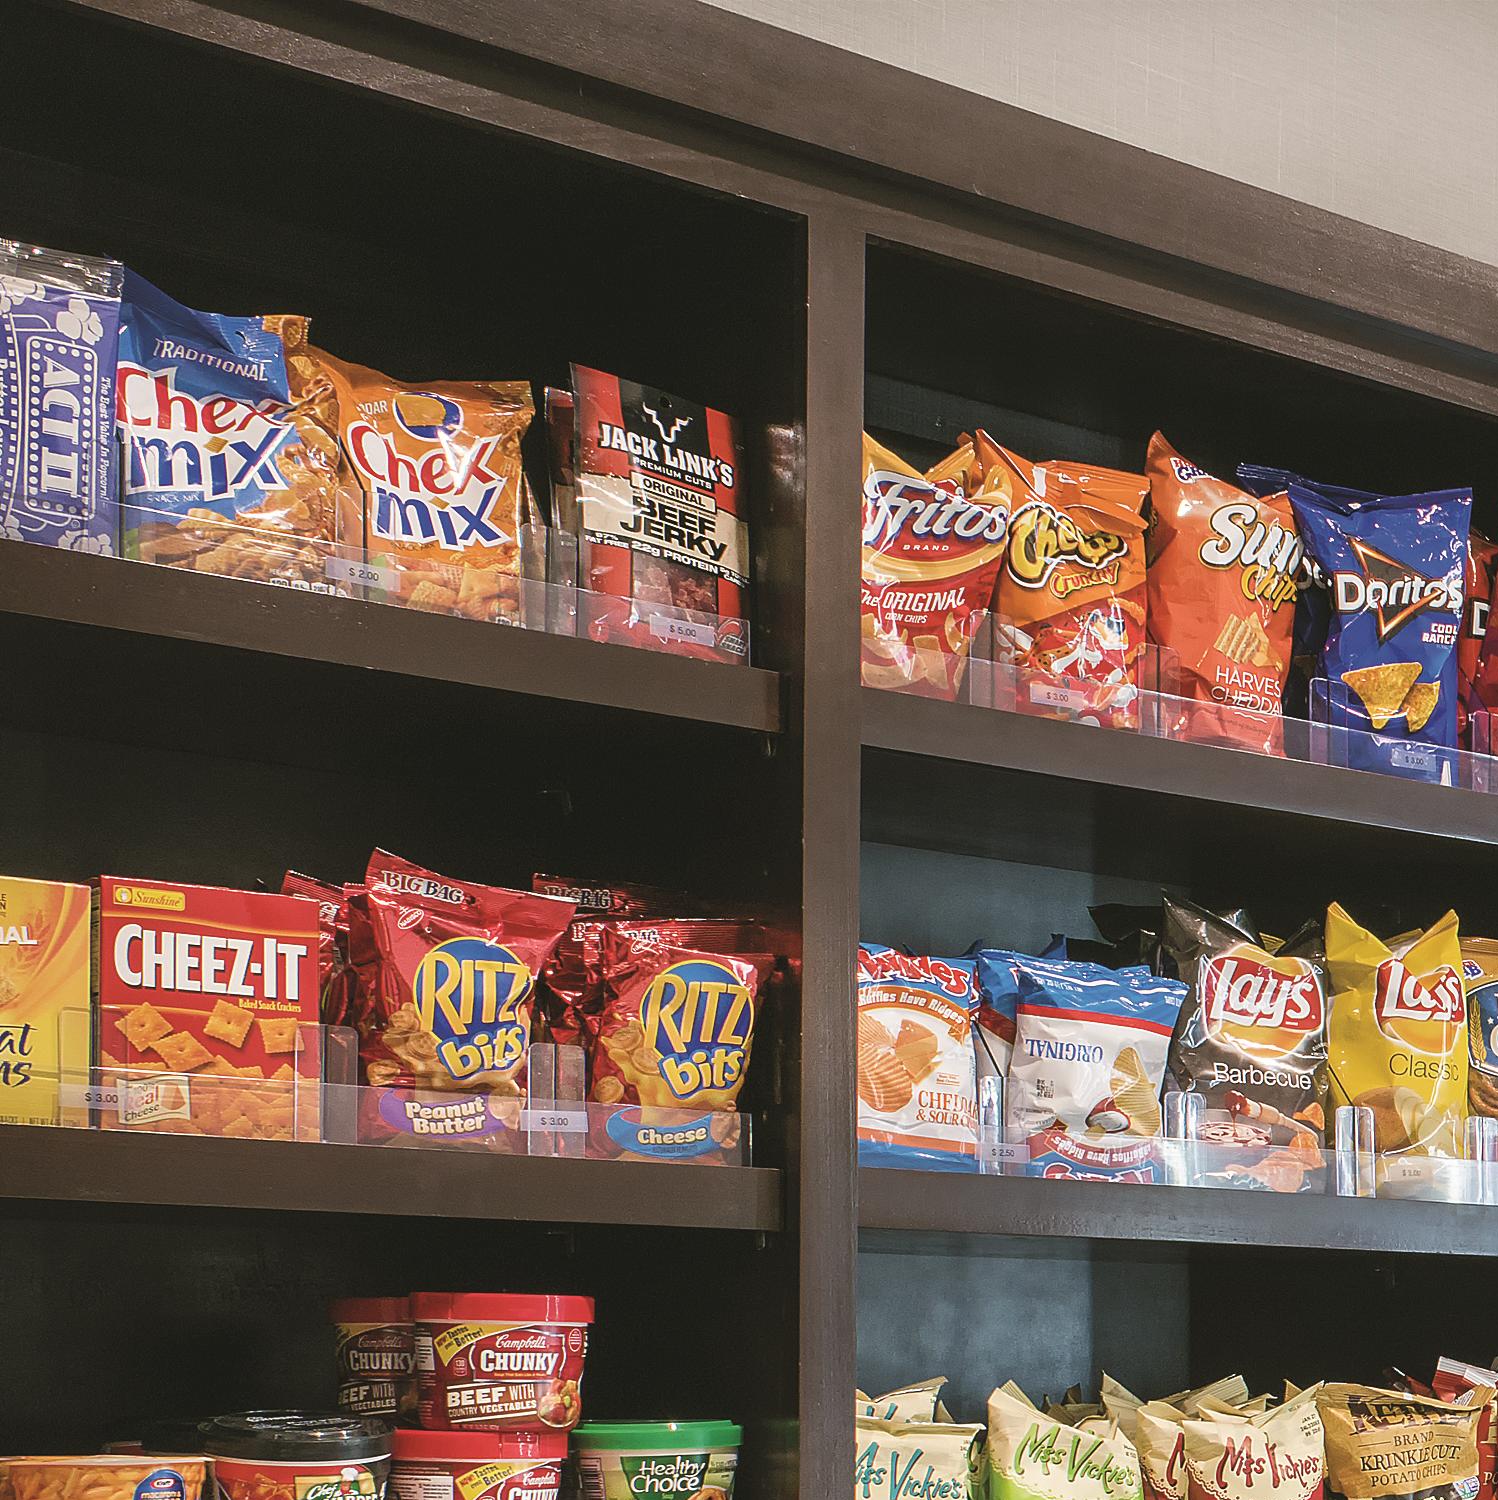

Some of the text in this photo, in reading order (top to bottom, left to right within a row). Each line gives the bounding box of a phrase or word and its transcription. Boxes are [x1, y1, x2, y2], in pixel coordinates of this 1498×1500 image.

[600, 424, 734, 487] JACK LINK'S
[633, 457, 712, 489] PREMIUM CUTS
[643, 478, 706, 507] ORIGINAL
[632, 541, 718, 574] 22g PROTEIN
[1336, 571, 1463, 612] Doritos
[669, 625, 696, 638] $ 5.00
[134, 890, 181, 907] Sunshine
[114, 924, 307, 1000] CHEEZ-IT
[421, 952, 531, 1034] RITZ
[643, 974, 750, 1053] RITZ
[441, 1024, 525, 1077] bits
[662, 1047, 744, 1097] bits
[1213, 1062, 1312, 1091] Barbecue
[1389, 1053, 1459, 1081] Classic
[85, 1092, 118, 1103] $ 3.00
[404, 1095, 485, 1121] Peanut
[412, 1115, 486, 1135] Butter
[637, 1126, 707, 1145] Cheese
[992, 1148, 1015, 1158] $ 2.50
[480, 1349, 558, 1373] CHUNKY
[446, 1384, 535, 1408] BEEF WITH
[448, 1399, 537, 1417] COUNTRY VEGETABLES
[1393, 1431, 1434, 1445] BRAND
[1014, 1422, 1137, 1494] Miss Vickie's
[1217, 1436, 1266, 1490] Miss
